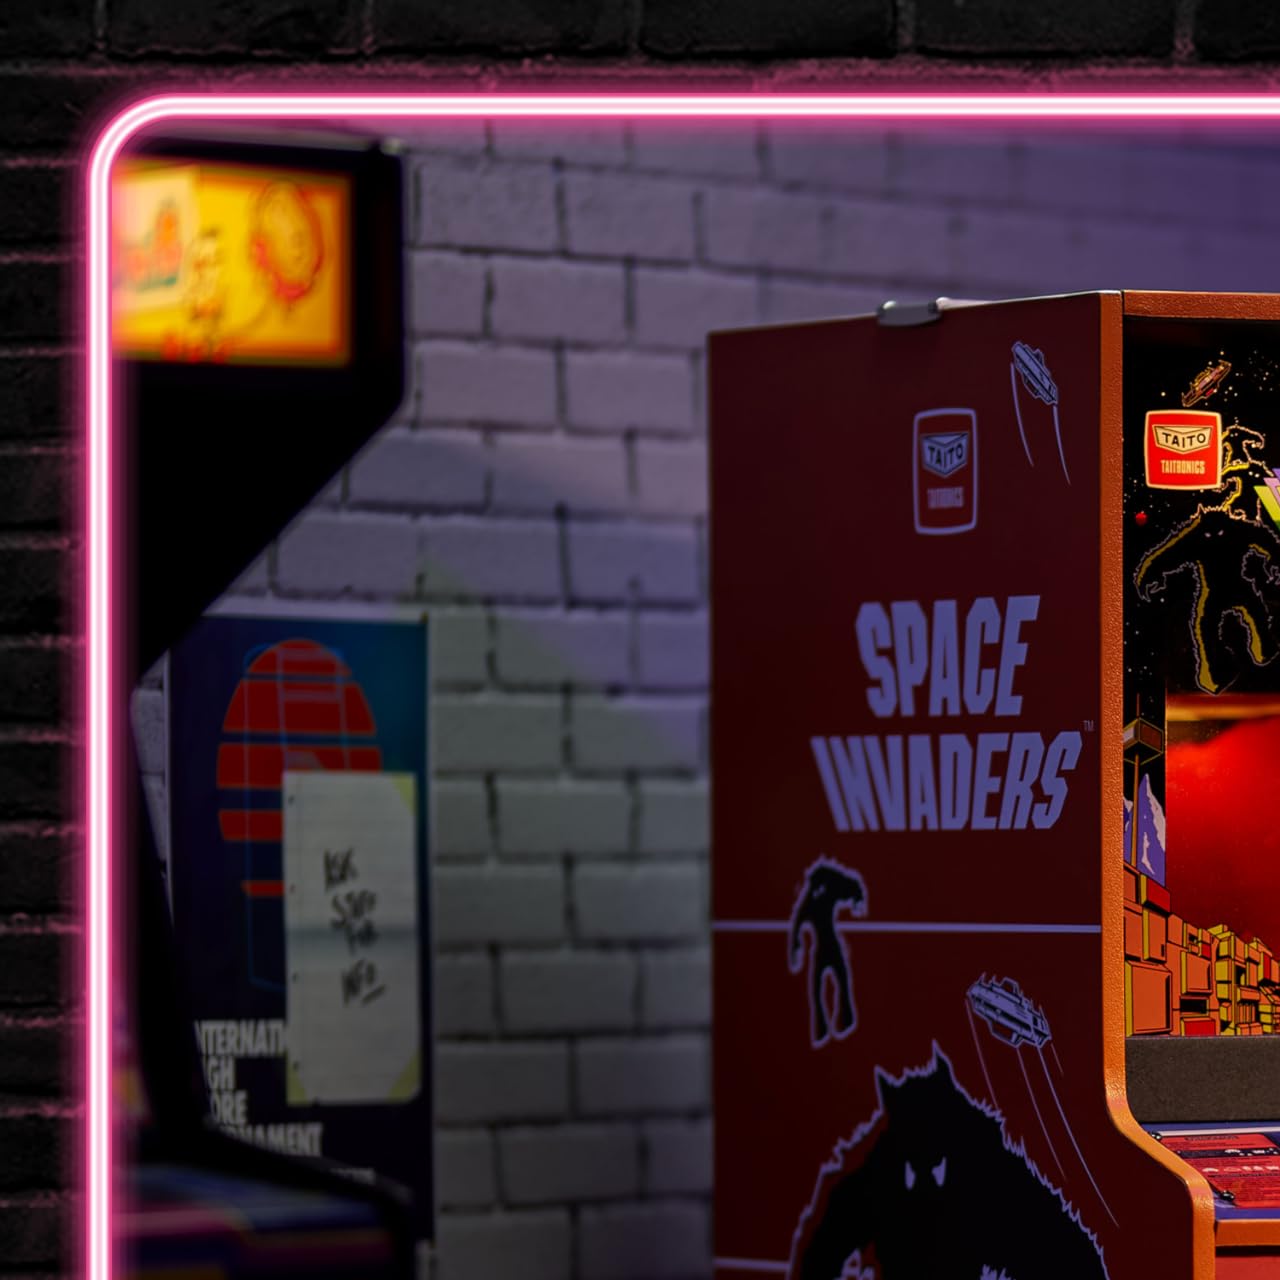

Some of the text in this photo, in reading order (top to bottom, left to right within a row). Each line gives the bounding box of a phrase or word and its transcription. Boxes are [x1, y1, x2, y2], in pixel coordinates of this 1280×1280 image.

[927, 442, 964, 468] TAITO
[1162, 432, 1206, 448] TAITO
[855, 594, 1041, 718] SPACE
[809, 731, 1083, 833] INVADERS
